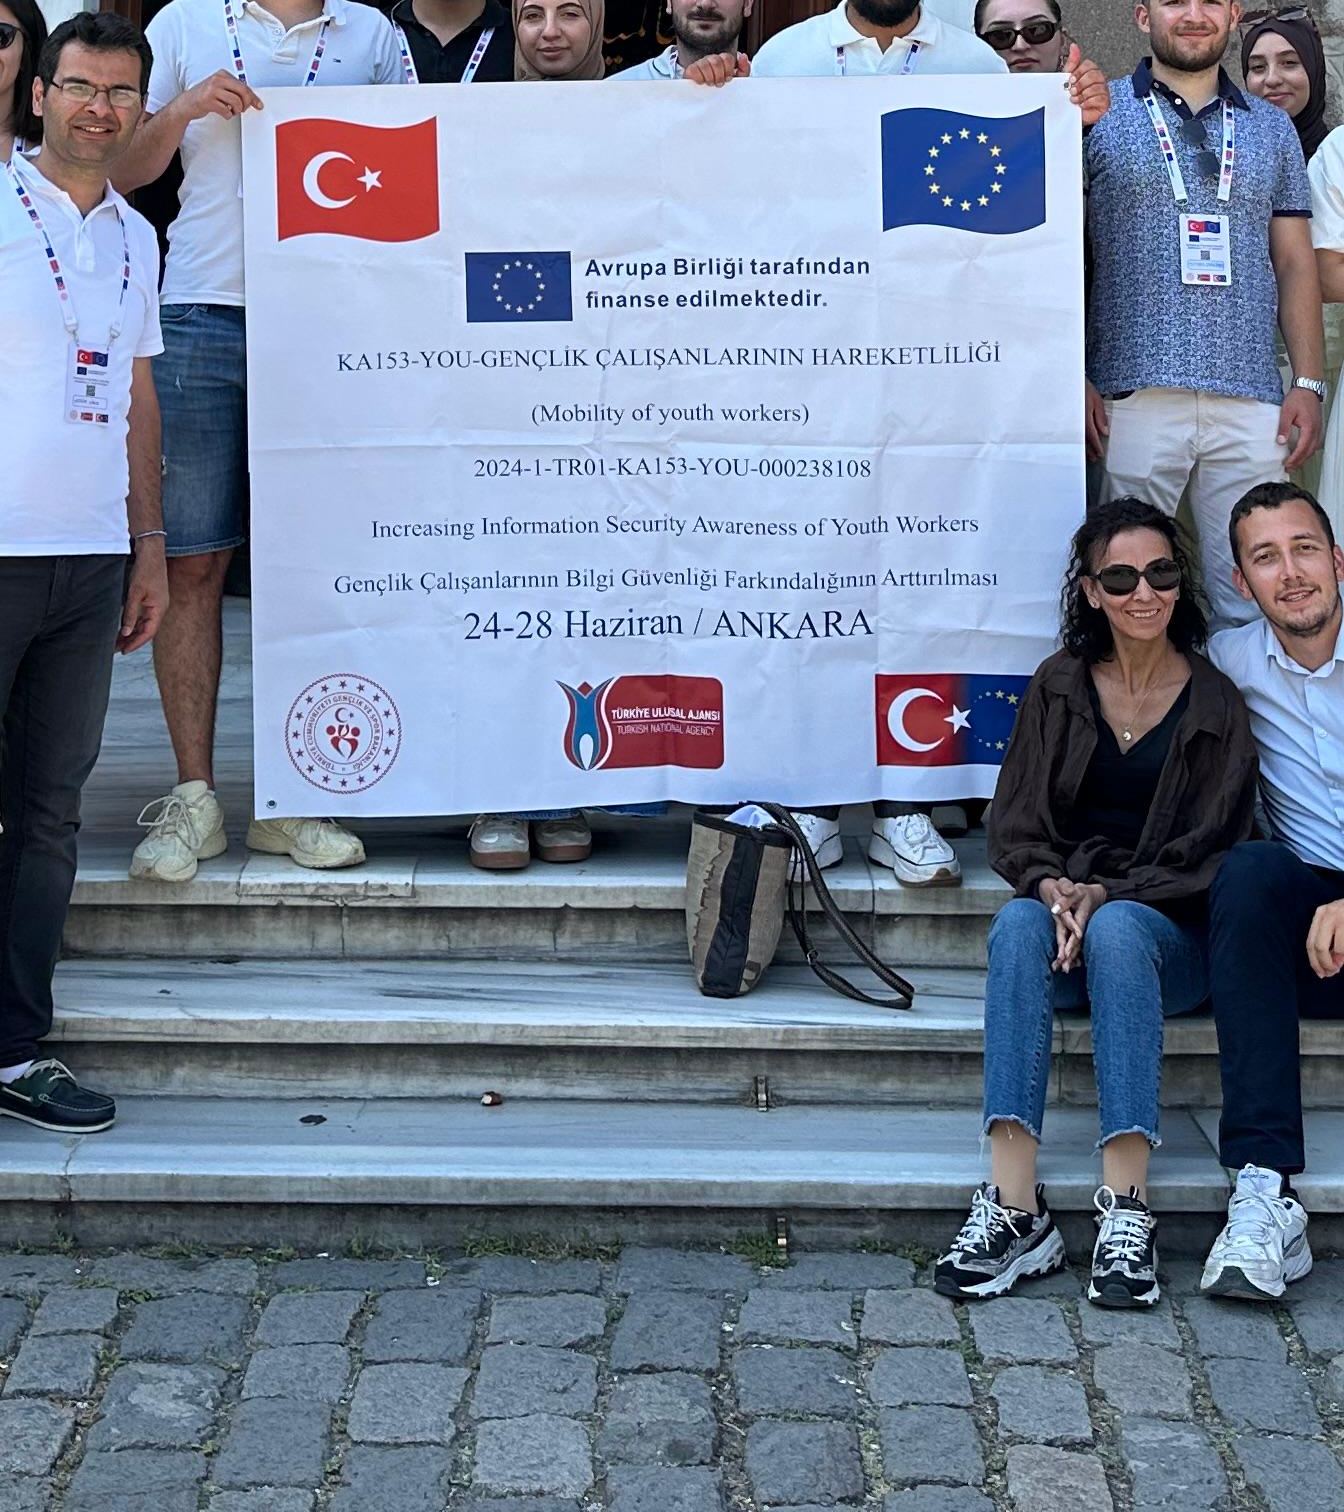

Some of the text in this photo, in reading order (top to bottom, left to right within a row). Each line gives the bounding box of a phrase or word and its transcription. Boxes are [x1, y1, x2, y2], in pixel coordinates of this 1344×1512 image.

[585, 257, 870, 279] Avrupa Birliği tarafından
[586, 289, 828, 308] finanse edilmektedir.
[337, 340, 1001, 371] KA153-YOU-GENÇLİK ÇALIŞANLARININ HAREKETLİLİĞİ
[531, 403, 809, 425] (Mobility of youth workers)
[473, 457, 871, 478] 2024-1-TR01-KA153-YOU-000238108
[371, 513, 979, 540] Increasing Information Security Awareness of Youth Workers
[334, 567, 998, 596] Gençlik Çalışanlarının Bilgi Güvenliği Farkındalığının Arttırılması
[463, 607, 875, 640] 24-28 Haziran / ANKARA
[611, 706, 720, 721] TÜRKİYE ULUSAL AJANSI
[617, 722, 715, 736] TURKISH NATIONAL AGENCY
